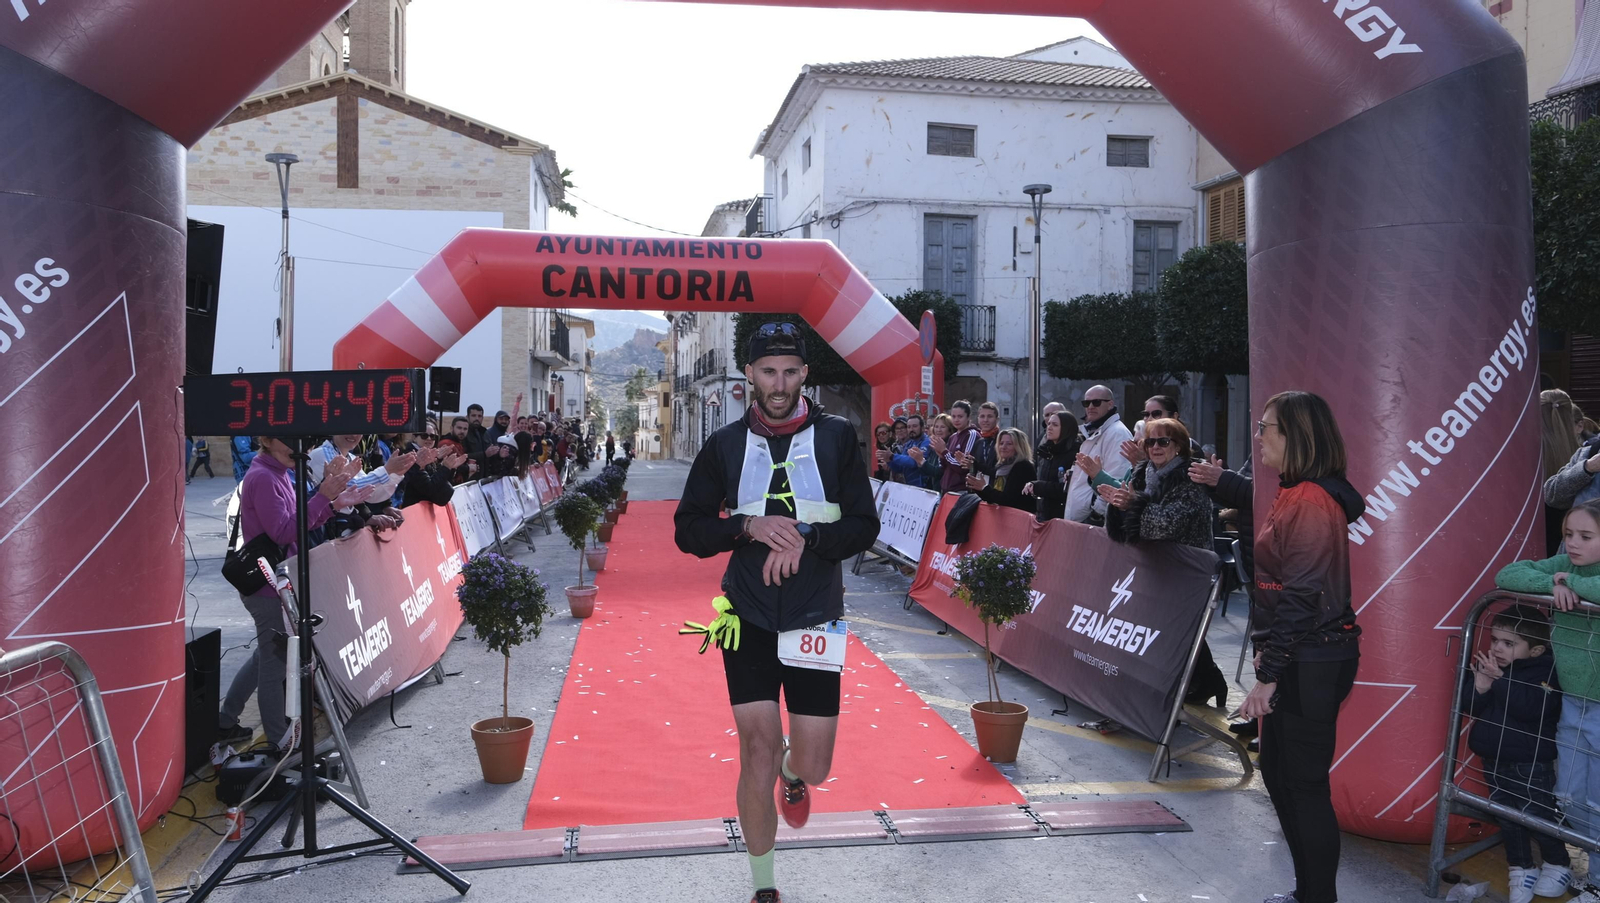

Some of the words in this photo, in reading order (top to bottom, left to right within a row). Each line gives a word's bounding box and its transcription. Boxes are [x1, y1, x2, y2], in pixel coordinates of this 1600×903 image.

[1322, 0, 1424, 60] RGY
[535, 235, 763, 260] AYUNTAMIENTO
[541, 264, 755, 303] CANTORIA
[228, 374, 412, 429] 3:04:48
[1347, 286, 1537, 546] www.teamergy.es
[399, 577, 435, 628] TEAMERGY
[338, 616, 393, 681] TEAMERGY
[799, 633, 827, 656] 80
[1065, 604, 1161, 657] TEAMERGY
